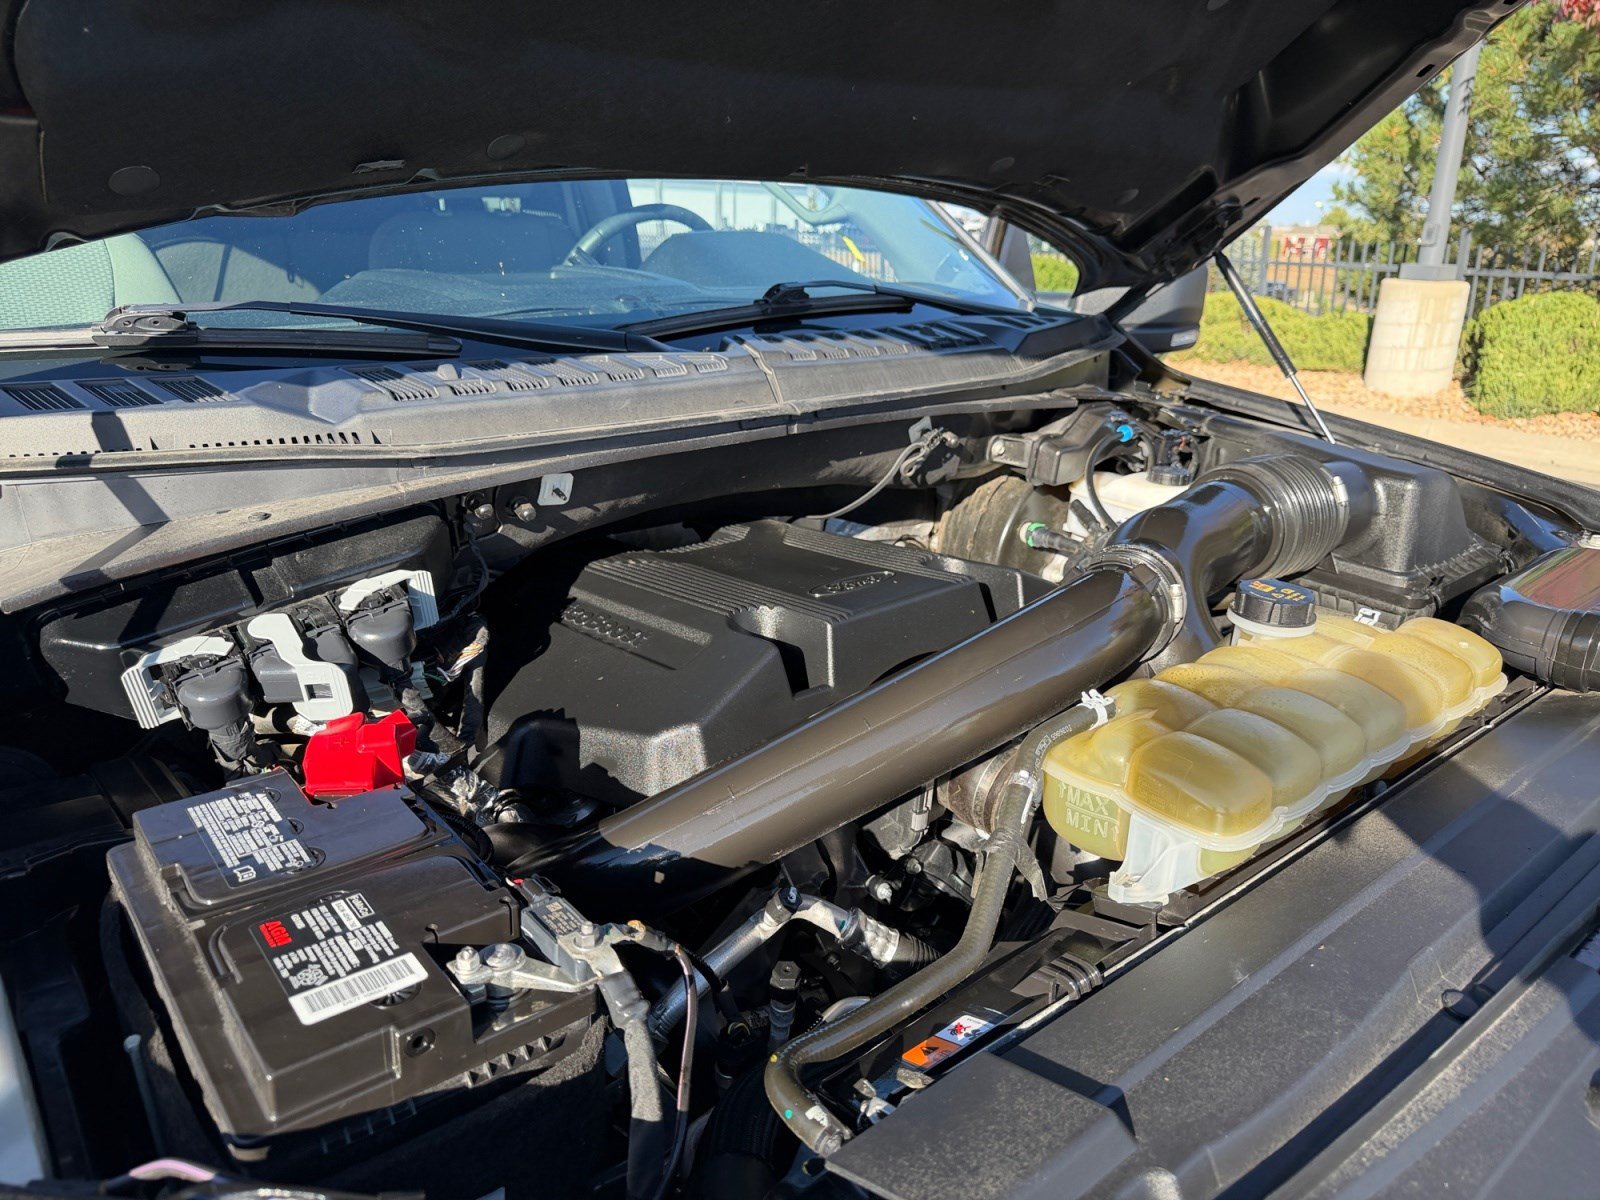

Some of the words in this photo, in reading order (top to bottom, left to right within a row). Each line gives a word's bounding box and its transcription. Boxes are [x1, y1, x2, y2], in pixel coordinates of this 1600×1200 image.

[1067, 785, 1109, 815] MAX
[1066, 808, 1108, 838] MIN
[264, 920, 292, 946] AGM
